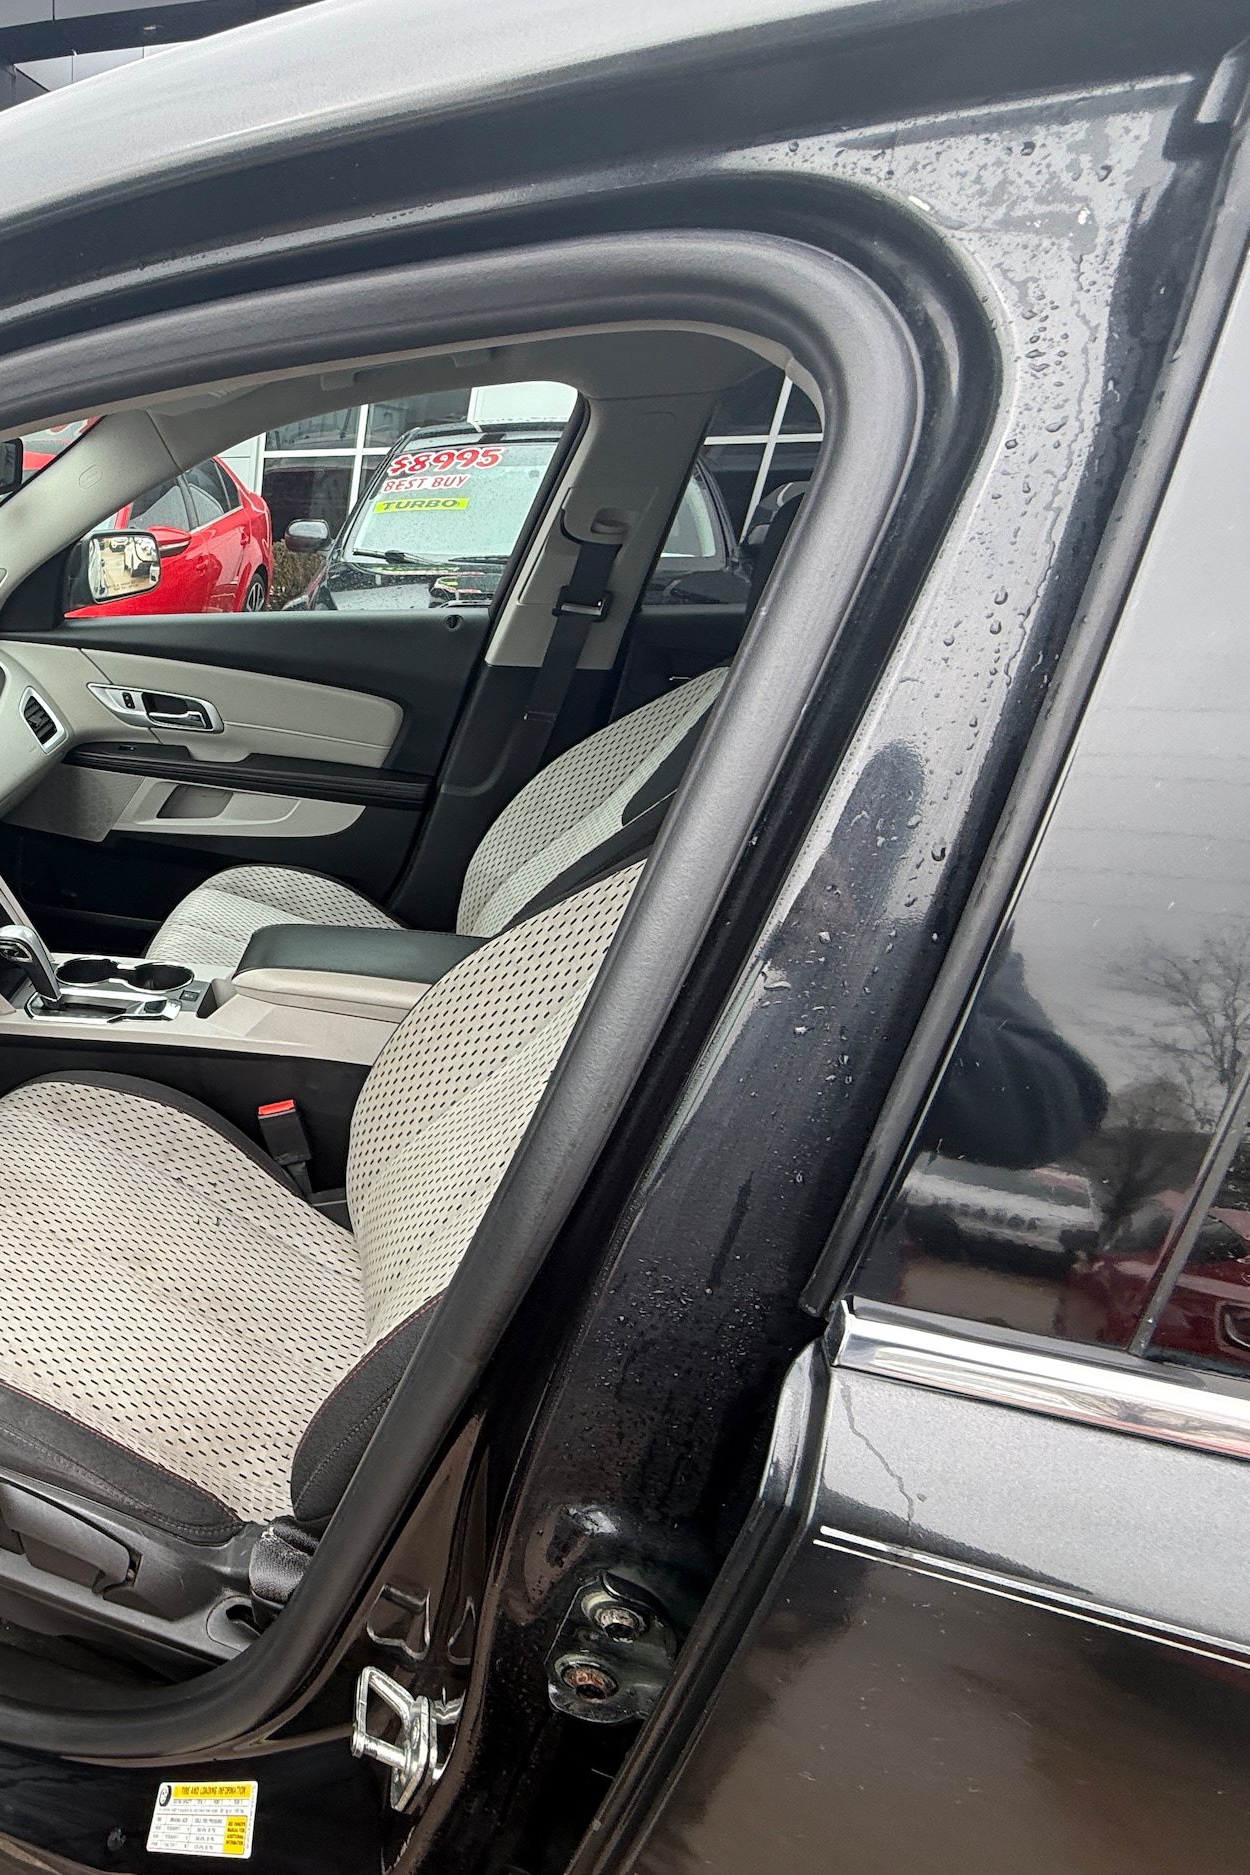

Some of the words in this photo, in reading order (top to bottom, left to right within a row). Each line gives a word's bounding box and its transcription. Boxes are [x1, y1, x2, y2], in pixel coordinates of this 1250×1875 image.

[388, 447, 505, 475] $8995
[383, 477, 428, 492] BEST
[431, 475, 468, 488] BUY
[382, 499, 459, 511] TURBO
